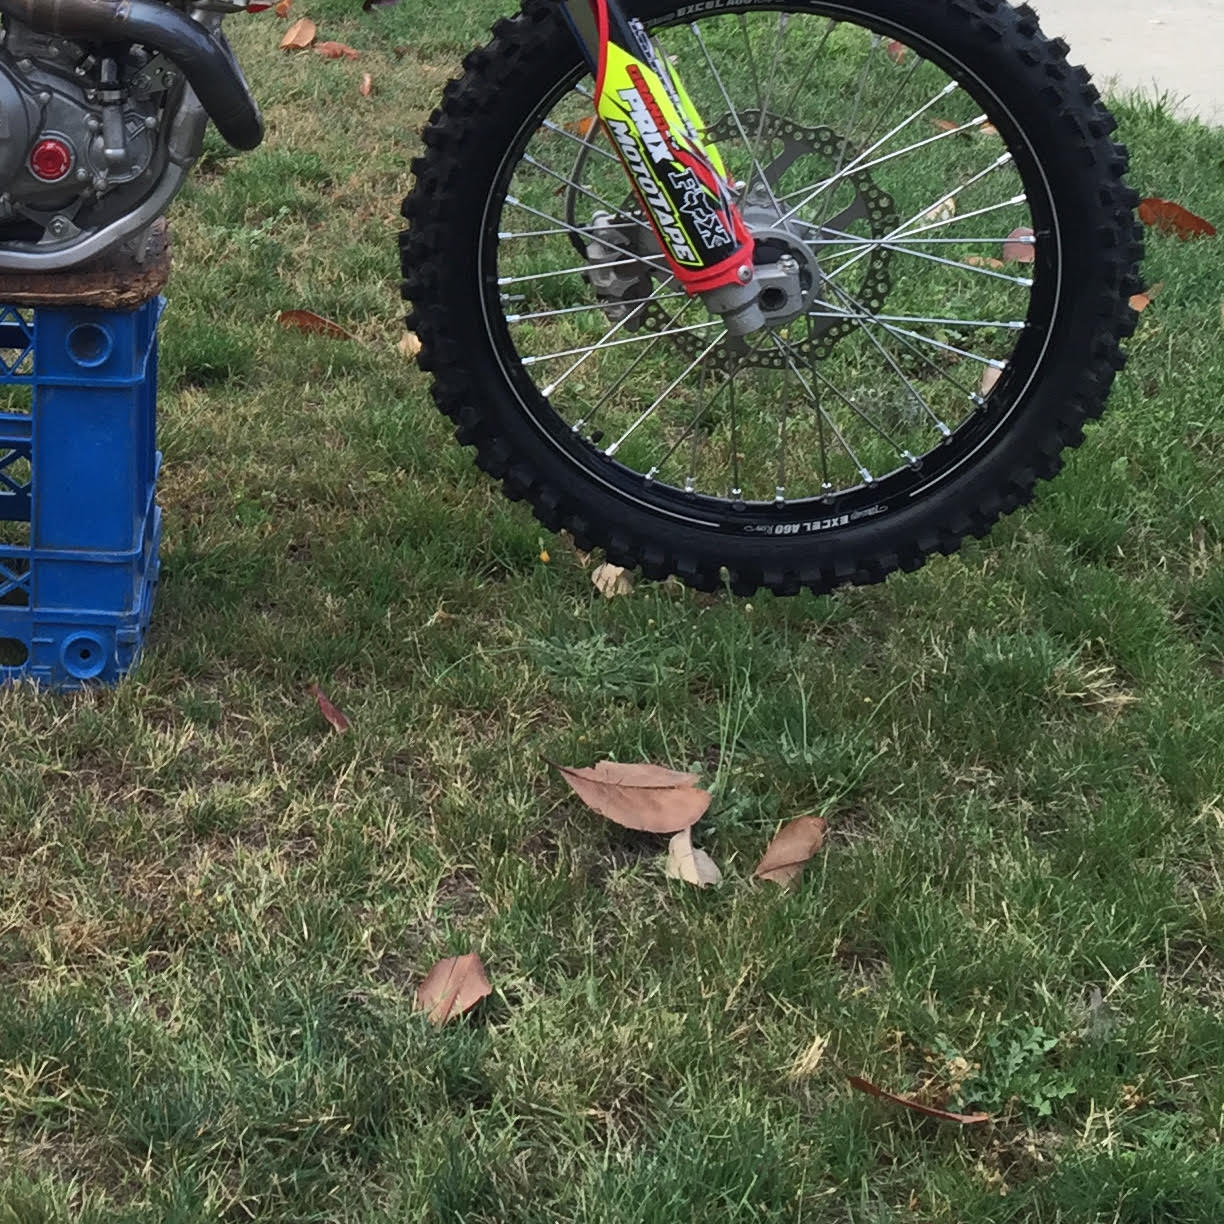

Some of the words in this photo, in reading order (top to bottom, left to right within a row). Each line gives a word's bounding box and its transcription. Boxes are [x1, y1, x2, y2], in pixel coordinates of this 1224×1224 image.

[677, 0, 724, 16] EXCEL
[618, 88, 674, 163] PRIX
[607, 119, 697, 263] MOTOTAPE
[803, 514, 849, 532] EXCEL
